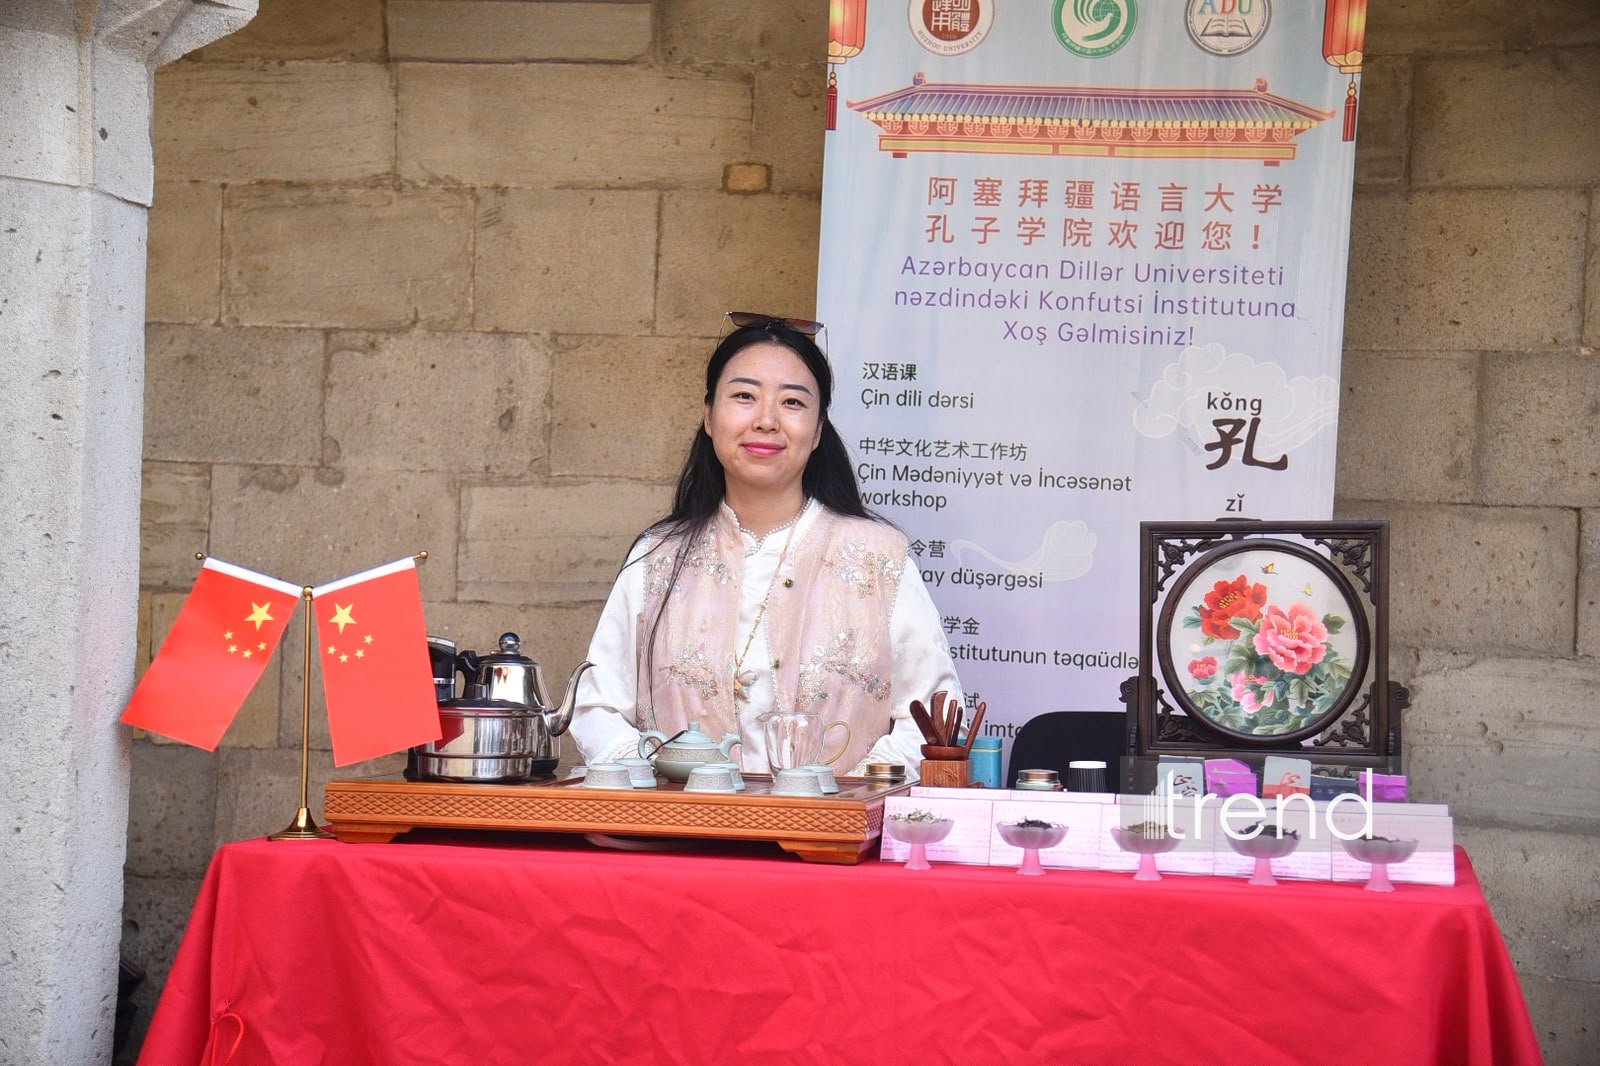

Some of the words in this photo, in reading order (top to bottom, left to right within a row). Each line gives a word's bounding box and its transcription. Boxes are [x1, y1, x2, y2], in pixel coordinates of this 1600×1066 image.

[943, 32, 983, 52] UNIVERSITY
[927, 176, 1283, 214] 阿塞拜疆语言大学
[901, 255, 1049, 283] Azərbaycan
[1060, 259, 1124, 282] Dillər
[1134, 262, 1284, 286] Universiteti
[894, 287, 1029, 310] nəzdindəki
[1039, 291, 1143, 314] Konfutsi
[1153, 290, 1296, 318] İnstitutuna
[1002, 320, 1047, 345] Xoş
[1057, 322, 1194, 346] Gəlmisiniz!
[862, 362, 917, 382] 汉语课
[861, 389, 890, 409] Çin
[896, 390, 922, 407] dili
[928, 391, 974, 409] dərsi
[1207, 392, 1262, 416] kǒng
[859, 437, 1028, 462] 中华文化艺术工作坊
[1204, 417, 1288, 471] 孔
[857, 463, 886, 483] Çin
[892, 464, 1004, 488] Mədəniyyət
[1009, 473, 1032, 487] və
[1038, 467, 1132, 492] İncəsənət
[861, 489, 947, 511] workshop
[1225, 493, 1245, 512] zǐ
[920, 569, 945, 587] ay
[950, 567, 1043, 591] düşərgəsi
